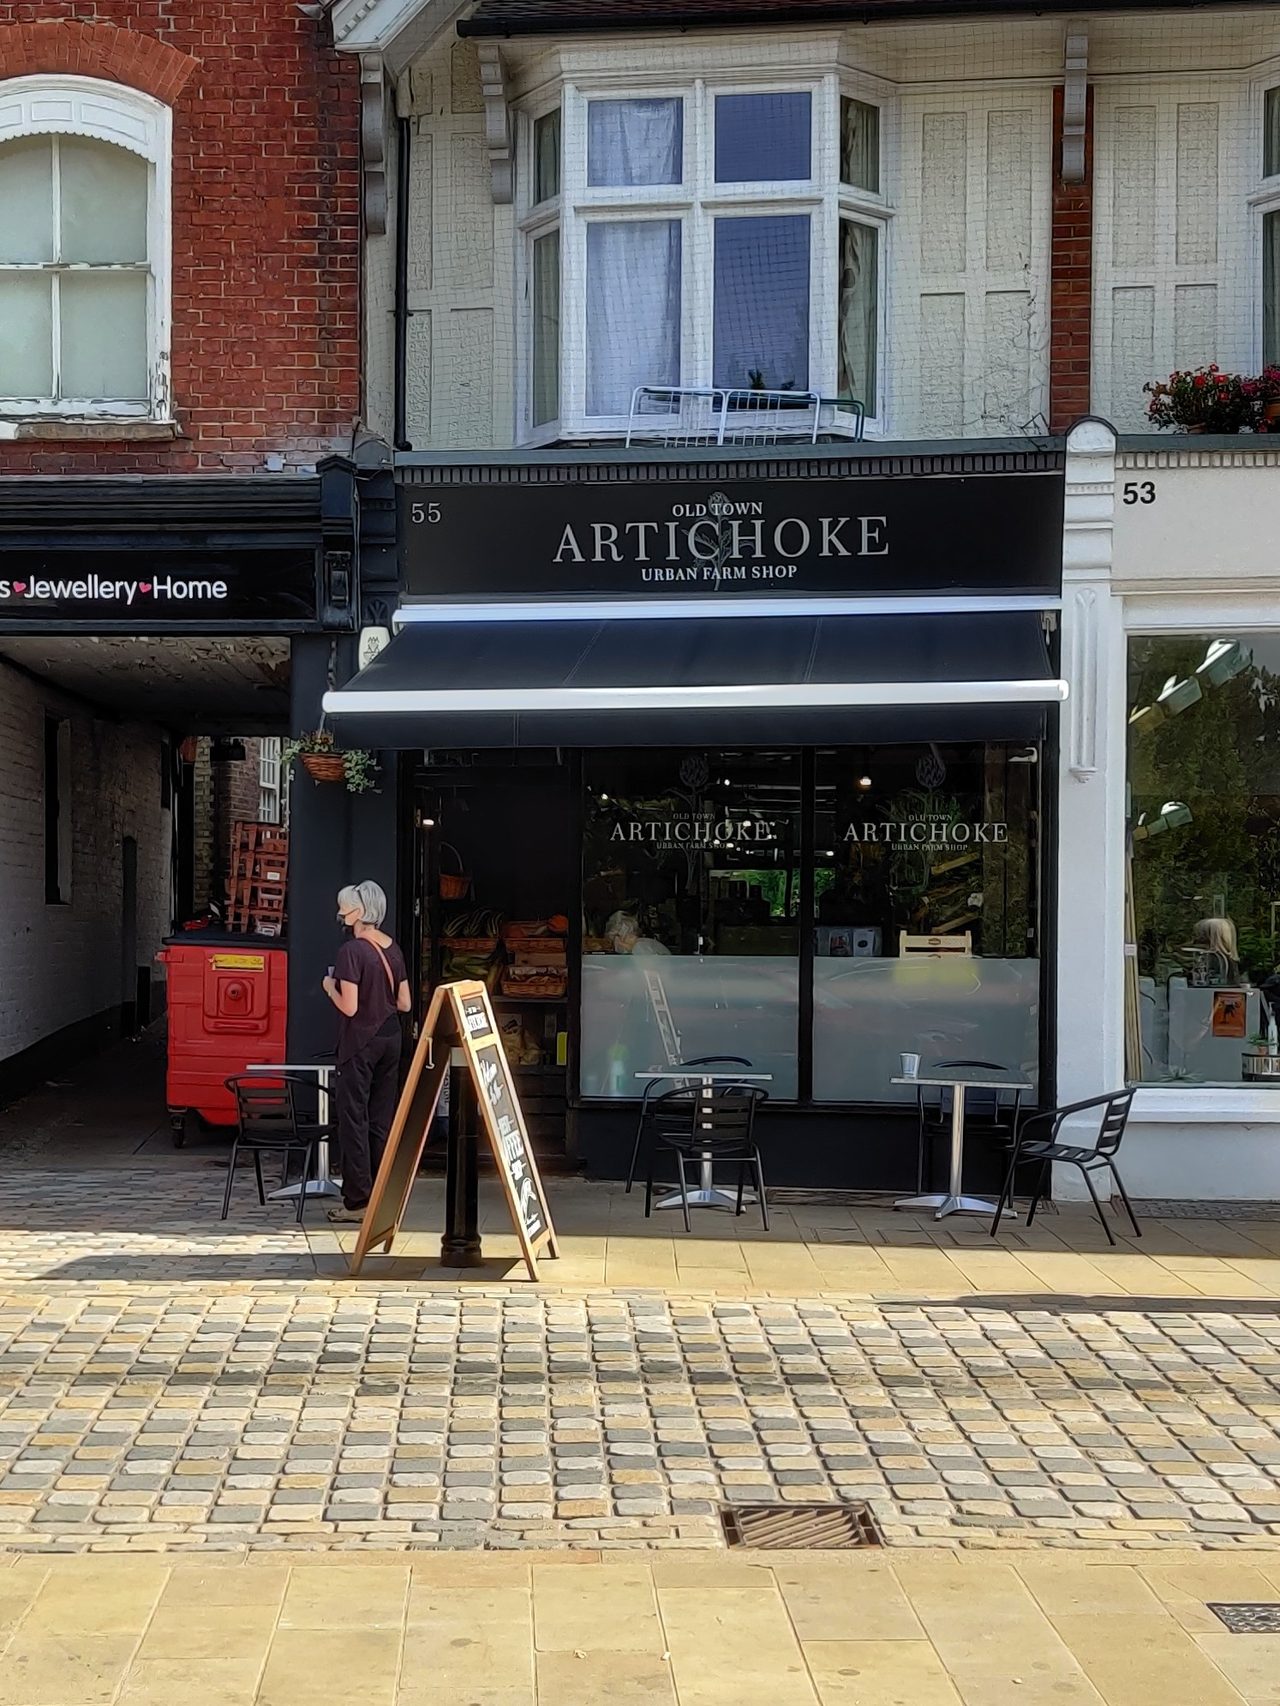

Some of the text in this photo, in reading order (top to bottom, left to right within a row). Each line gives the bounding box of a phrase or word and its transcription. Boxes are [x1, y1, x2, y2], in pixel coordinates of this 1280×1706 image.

[1122, 481, 1157, 505] 53
[411, 502, 442, 524] 55
[672, 502, 763, 517] OLD TOWN
[552, 516, 889, 562] ARTICHOKE
[641, 565, 798, 581] URBAN FARM SHOP
[24, 574, 138, 606] Jewellery
[153, 575, 228, 599] Home
[927, 813, 953, 821] TOWN
[609, 822, 770, 841] ARTICHOKE
[843, 822, 1009, 842] ARTICHOKE
